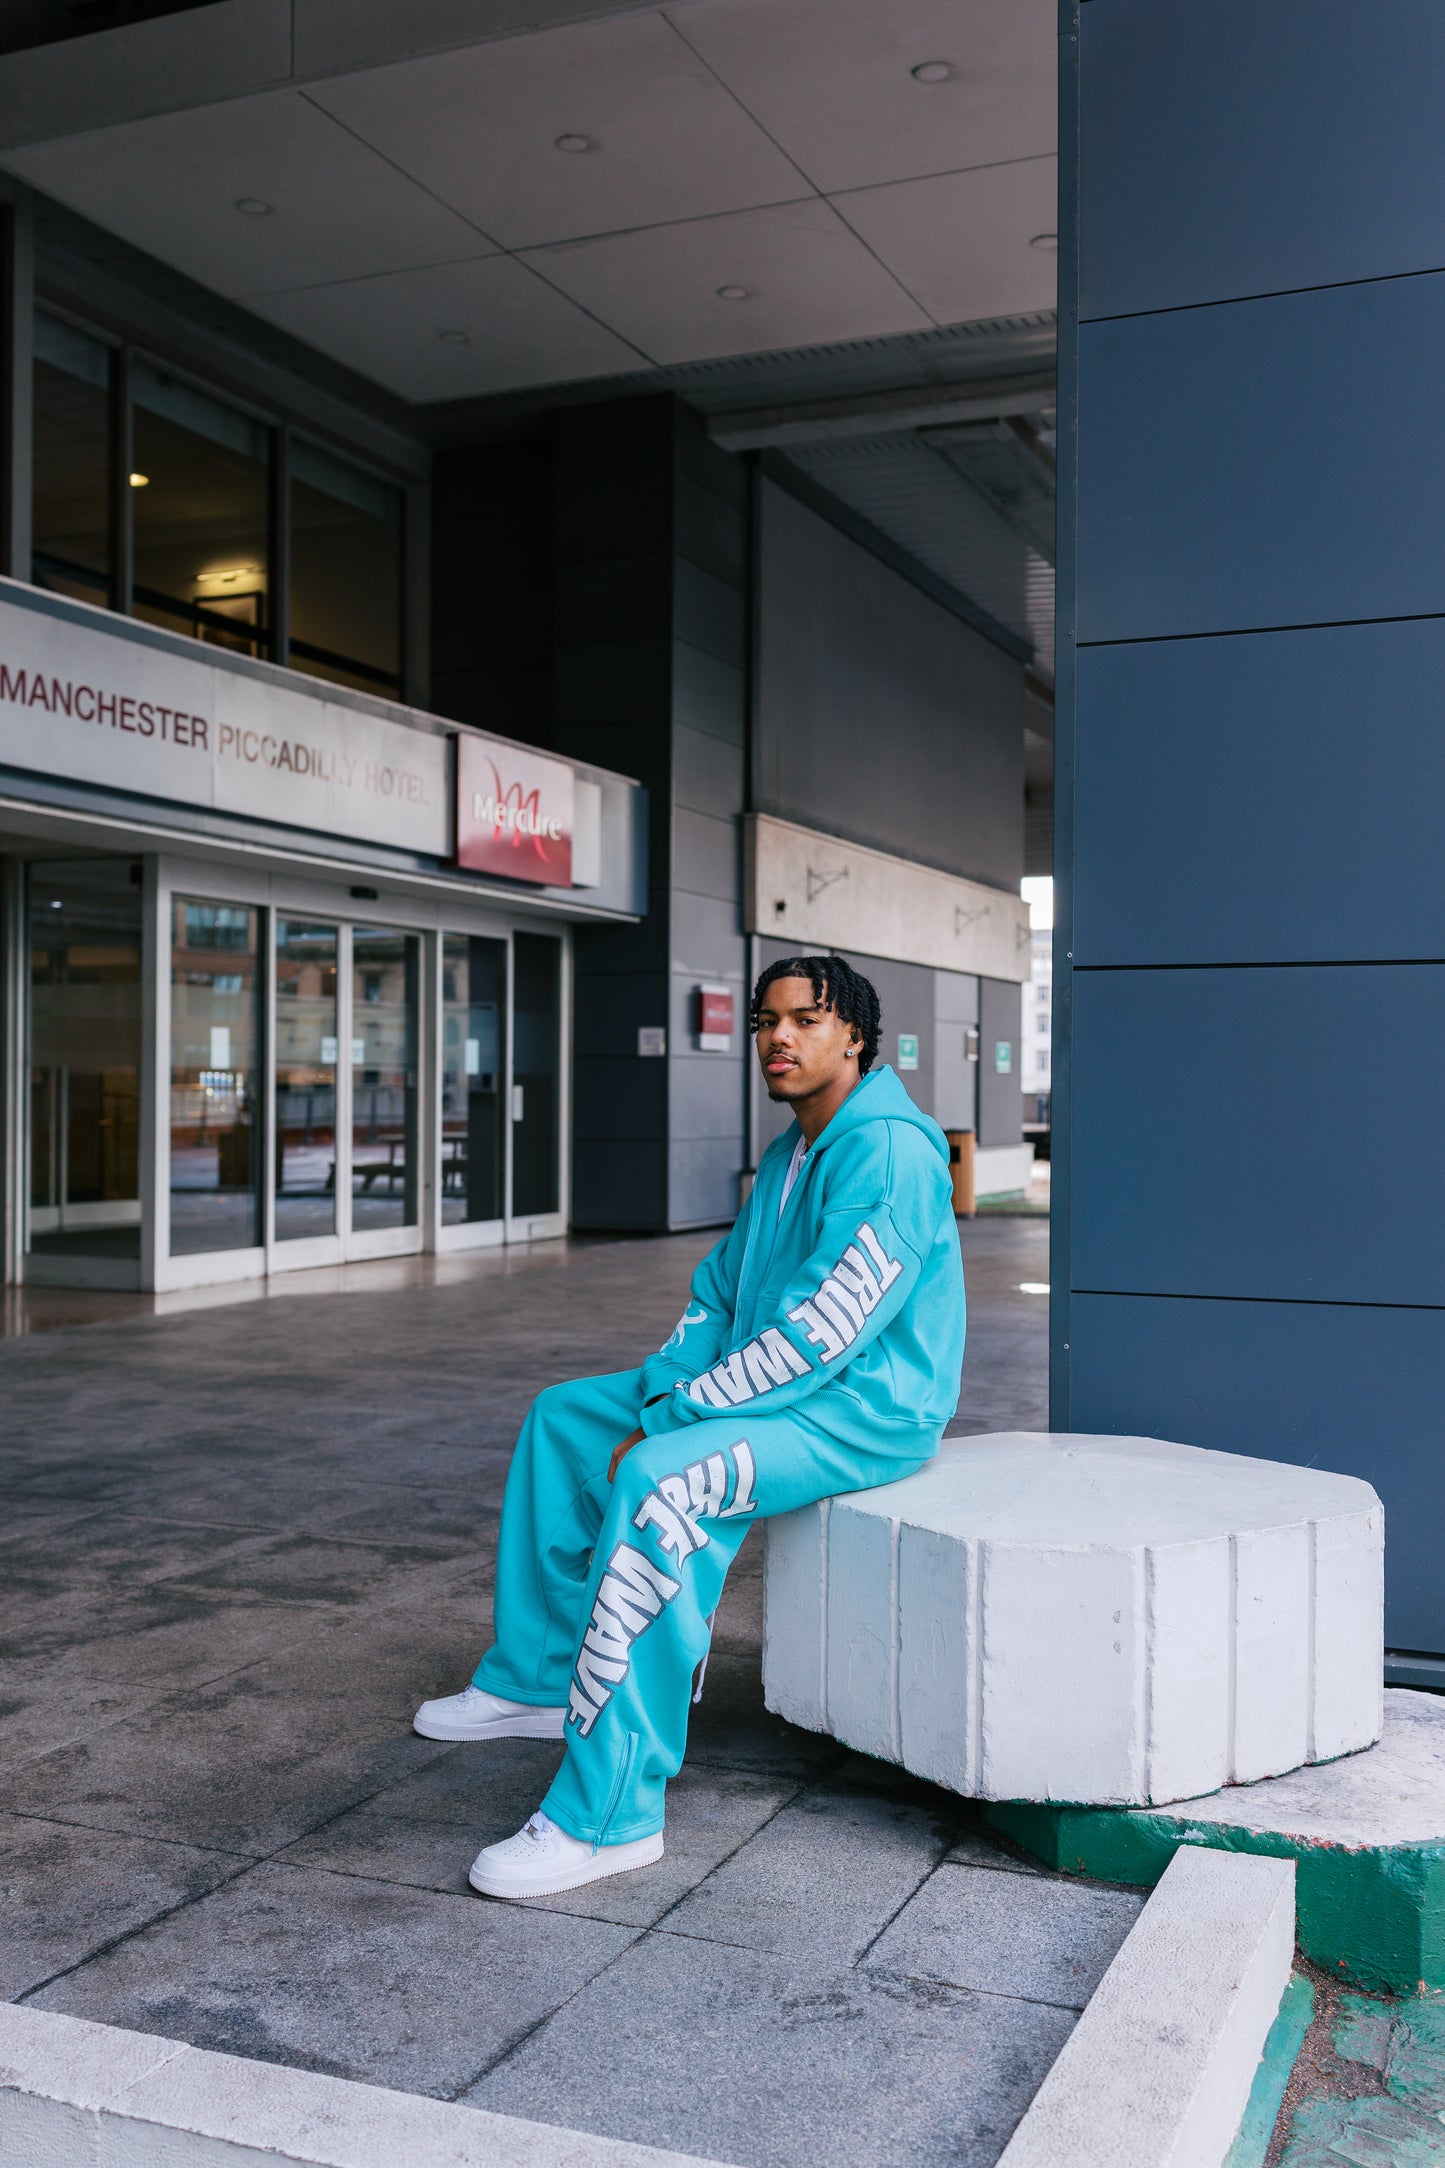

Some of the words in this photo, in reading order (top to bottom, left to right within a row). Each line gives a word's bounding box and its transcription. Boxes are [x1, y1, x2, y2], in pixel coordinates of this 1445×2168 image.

[0, 666, 208, 751] MANCHESTER
[218, 723, 357, 788] PICCADILLY
[364, 762, 430, 806] HOTEL
[474, 792, 562, 841] Mercure
[785, 1221, 904, 1365] TRUE
[674, 1327, 814, 1408] WAV
[631, 1437, 759, 1573] TRUE
[568, 1540, 682, 1740] WAVE
